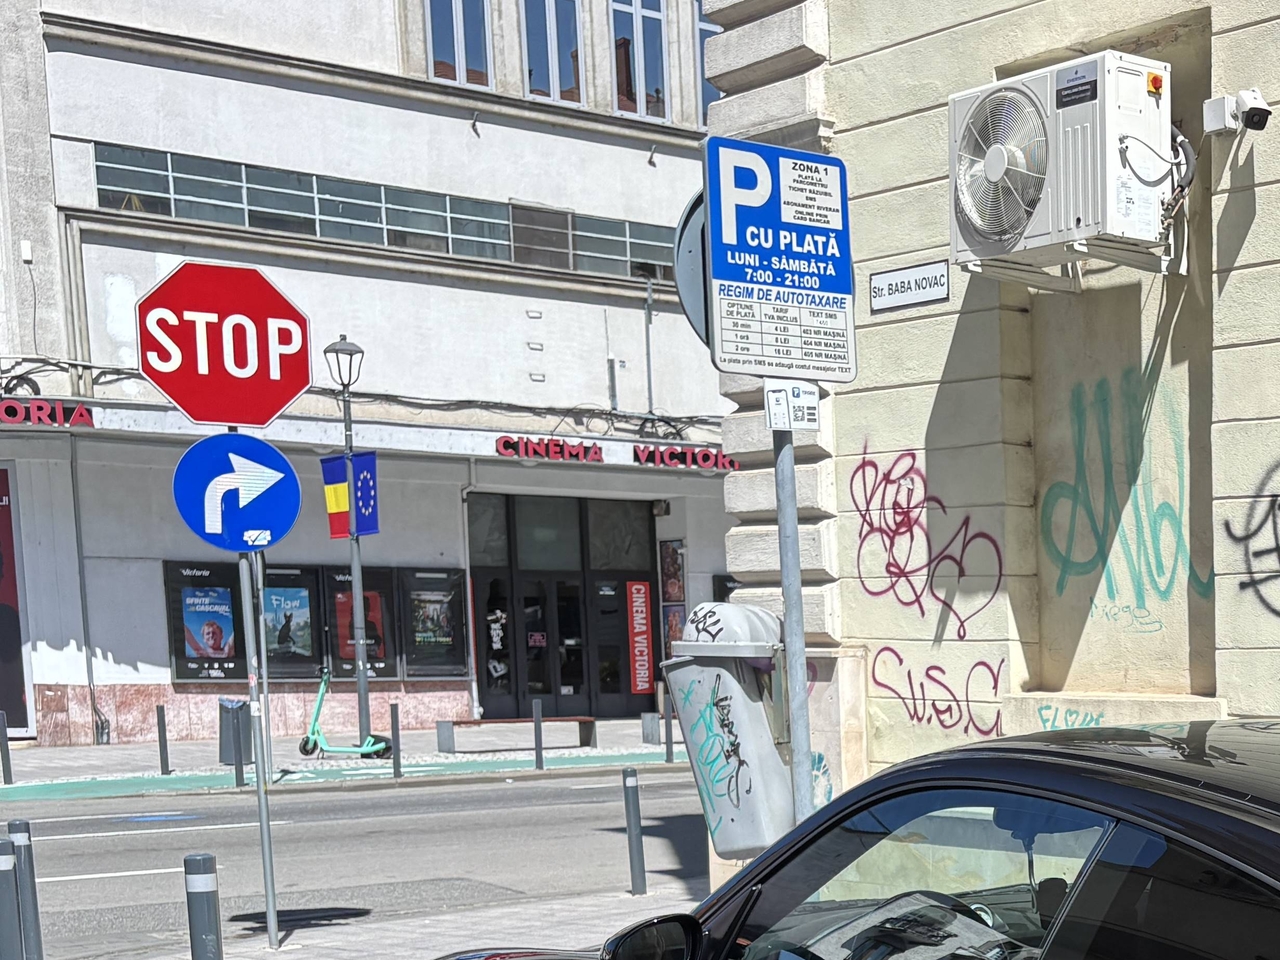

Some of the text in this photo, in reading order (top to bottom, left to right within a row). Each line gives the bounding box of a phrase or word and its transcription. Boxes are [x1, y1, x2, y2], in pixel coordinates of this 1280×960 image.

[791, 162, 828, 176] ZONA 1
[719, 147, 772, 246] P
[788, 185, 807, 193] TICHET
[783, 200, 815, 210] ABONAMENT
[808, 217, 830, 225] BANCAR
[746, 226, 841, 257] CU PLATĂ
[727, 250, 759, 267] LUNI
[771, 255, 836, 276] SÂMBĂTĂ
[745, 268, 773, 283] 7:00
[784, 273, 820, 289] 21:00
[872, 274, 946, 299] Str. BABA NOVAC
[718, 284, 847, 309] REGIM DE AUTOTAXARE
[763, 313, 798, 324] TVA INCLUS
[772, 306, 789, 314] TARIF
[809, 310, 837, 320] TEXT SMS
[146, 308, 302, 380] STOP
[838, 366, 851, 374] TEXT
[0, 399, 94, 428] ORIA
[496, 435, 604, 464] CINEMA
[182, 568, 210, 577] Victoria
[270, 595, 300, 609] Flow
[631, 584, 650, 691] CINEMA VICTORIA
